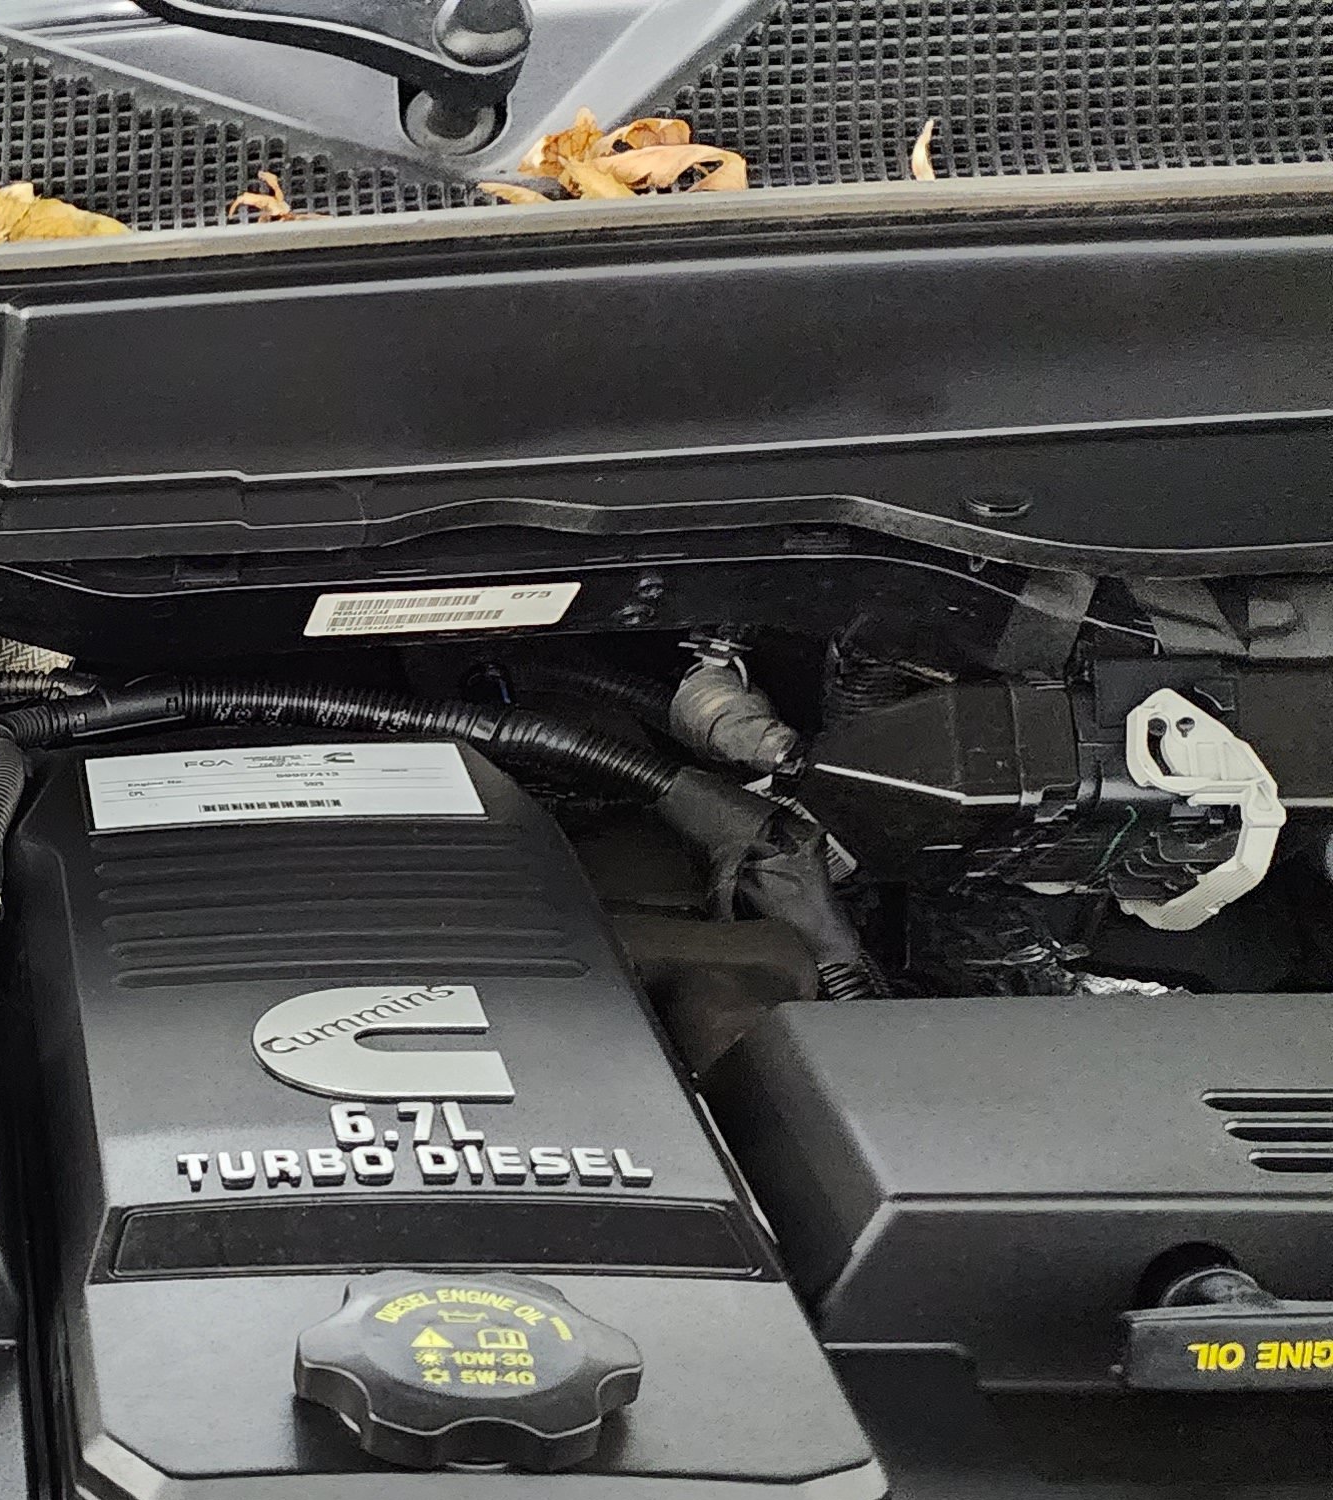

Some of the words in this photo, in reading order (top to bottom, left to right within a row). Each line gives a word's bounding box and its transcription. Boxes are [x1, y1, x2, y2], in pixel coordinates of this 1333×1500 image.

[184, 759, 234, 768] FCA
[260, 984, 456, 1054] Cummins
[330, 1101, 484, 1151] 6.7L
[176, 1146, 396, 1190] TURBO
[415, 1144, 655, 1189] DIESEL
[374, 1291, 438, 1324] DIESEL
[435, 1288, 518, 1312] ENGINE
[513, 1304, 547, 1326] OIL
[451, 1351, 535, 1367] 10W-30
[1186, 1340, 1246, 1371] OIL
[459, 1369, 537, 1386] 5W-40
